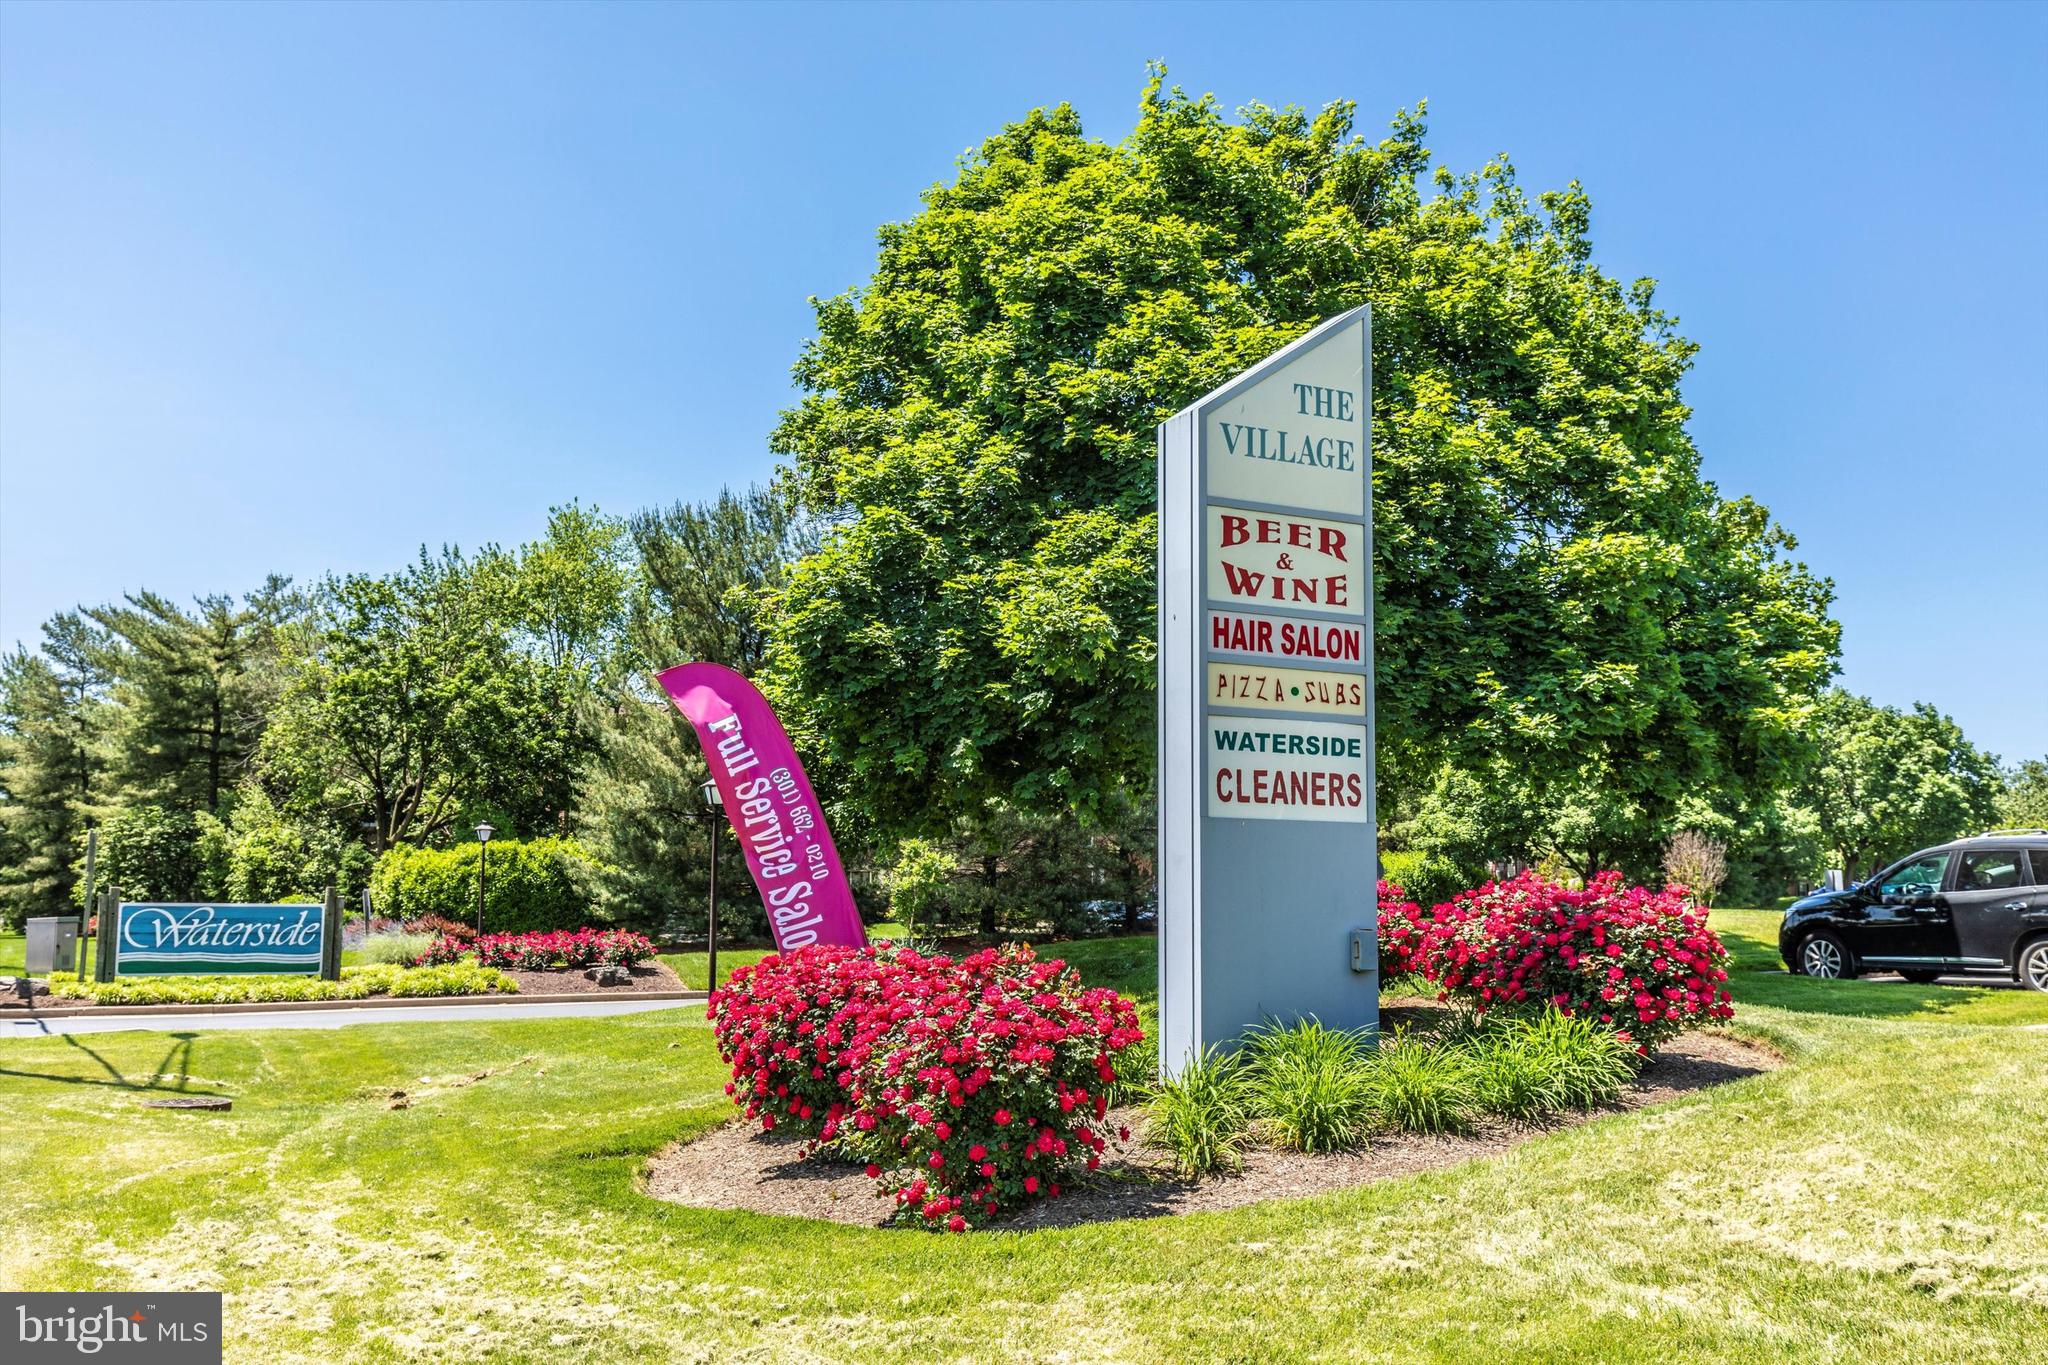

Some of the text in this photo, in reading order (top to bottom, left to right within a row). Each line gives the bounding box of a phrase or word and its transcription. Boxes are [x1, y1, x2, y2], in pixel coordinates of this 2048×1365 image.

[1293, 383, 1354, 423] THE
[1219, 421, 1355, 472] VILLAGE
[1220, 514, 1348, 563] BEER
[1276, 552, 1294, 571] &
[1220, 560, 1348, 607] WINE
[1213, 616, 1360, 661] HAIR SALON
[1216, 673, 1361, 706] PIZZA SUBS
[1214, 729, 1361, 758] WATERSIDE
[708, 713, 760, 778] Full
[735, 777, 797, 879] Service
[1216, 767, 1362, 808] CLEANERS
[770, 767, 801, 805] (301)
[789, 805, 815, 834] 662
[805, 843, 829, 880] 0210
[124, 906, 321, 948] Waterside
